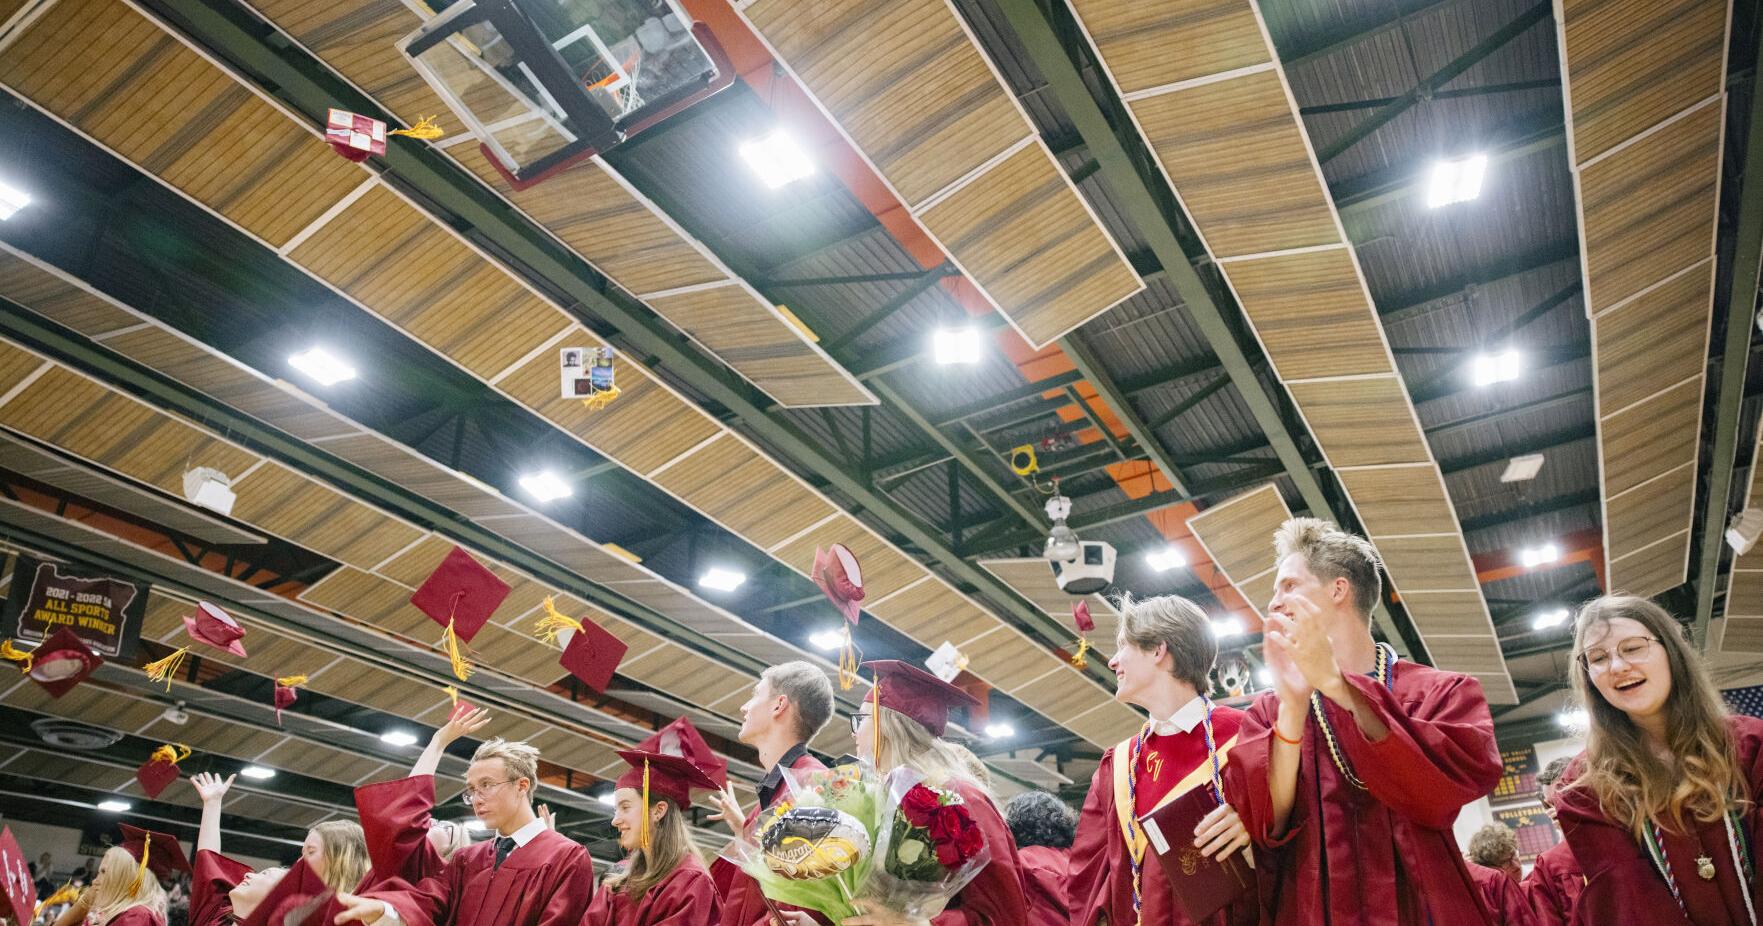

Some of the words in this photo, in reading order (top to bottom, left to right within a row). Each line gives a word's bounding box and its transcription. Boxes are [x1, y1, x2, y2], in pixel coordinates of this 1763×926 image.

[46, 586, 69, 600] 2021
[76, 592, 102, 604] 2022
[45, 599, 67, 612] ALL
[70, 603, 110, 620] SPORTS
[34, 609, 74, 625] AWARD
[78, 616, 116, 635] WINNER
